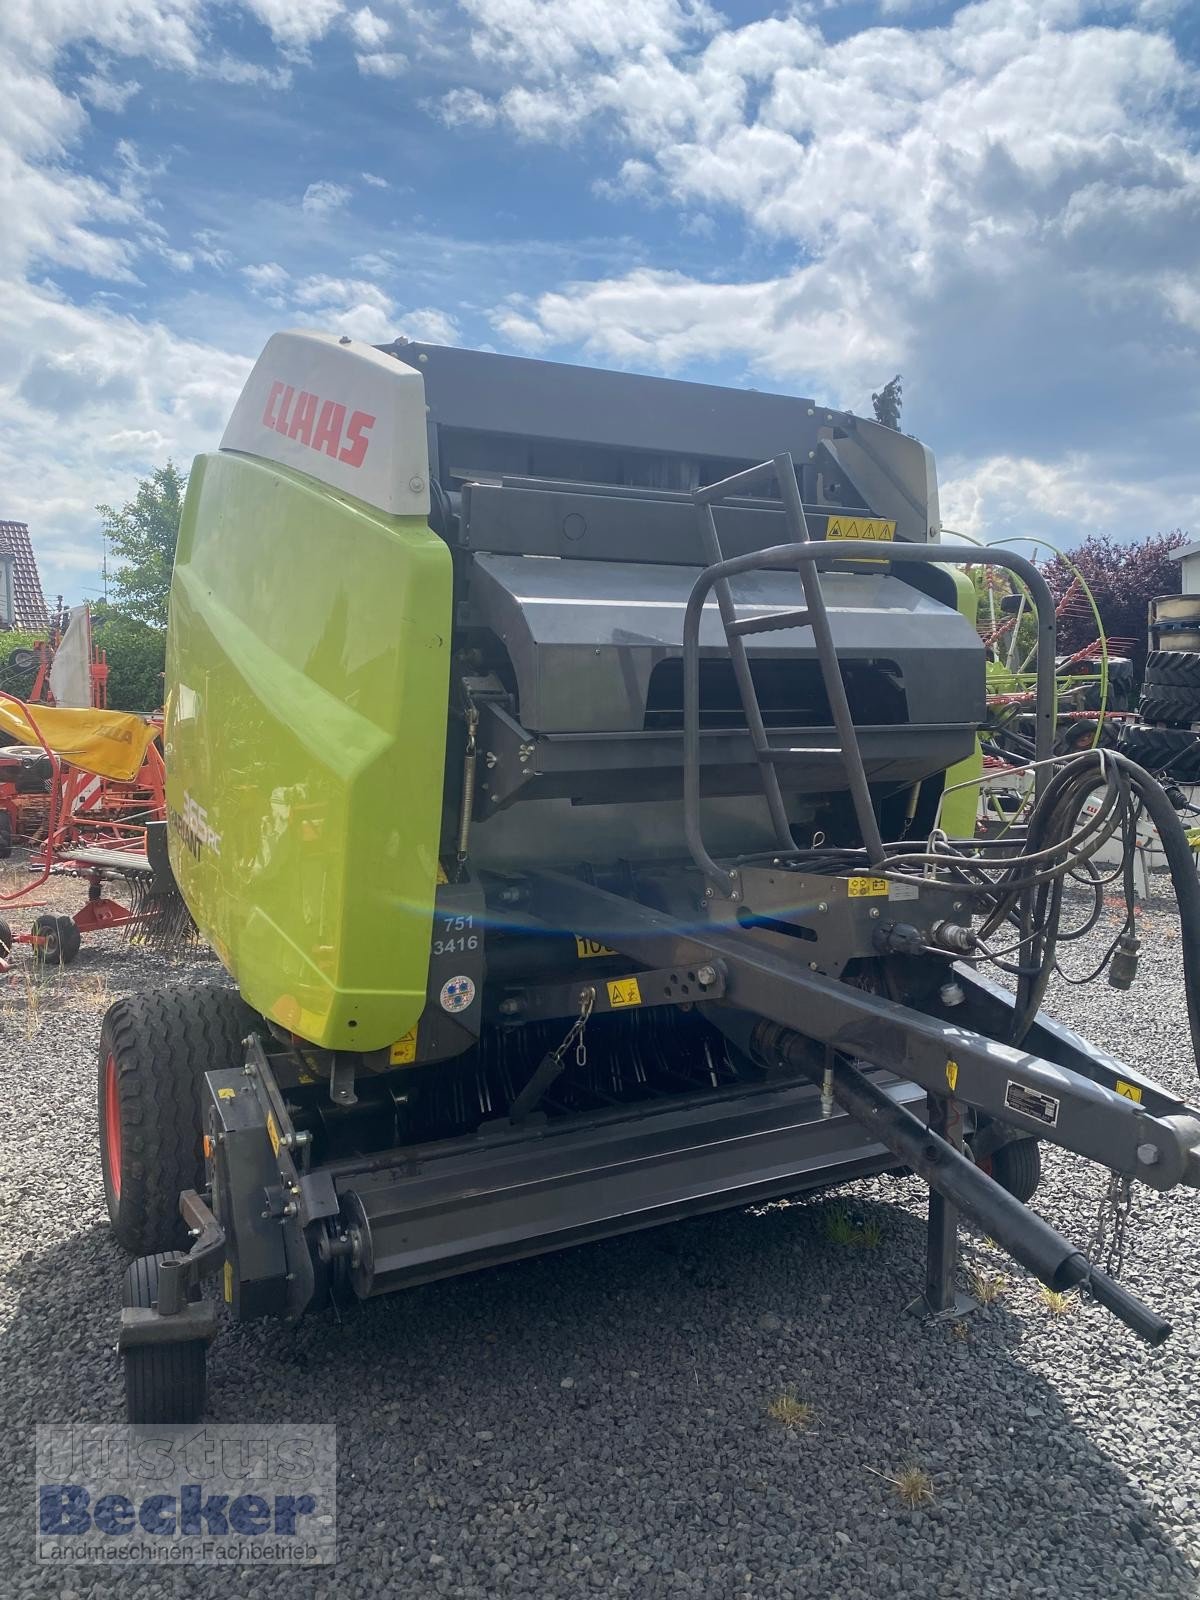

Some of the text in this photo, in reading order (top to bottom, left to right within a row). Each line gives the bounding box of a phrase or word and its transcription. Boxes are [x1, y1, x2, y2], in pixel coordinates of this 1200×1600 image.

[262, 381, 376, 469] CLAAS
[444, 915, 474, 932] 751
[433, 935, 478, 955] 3416
